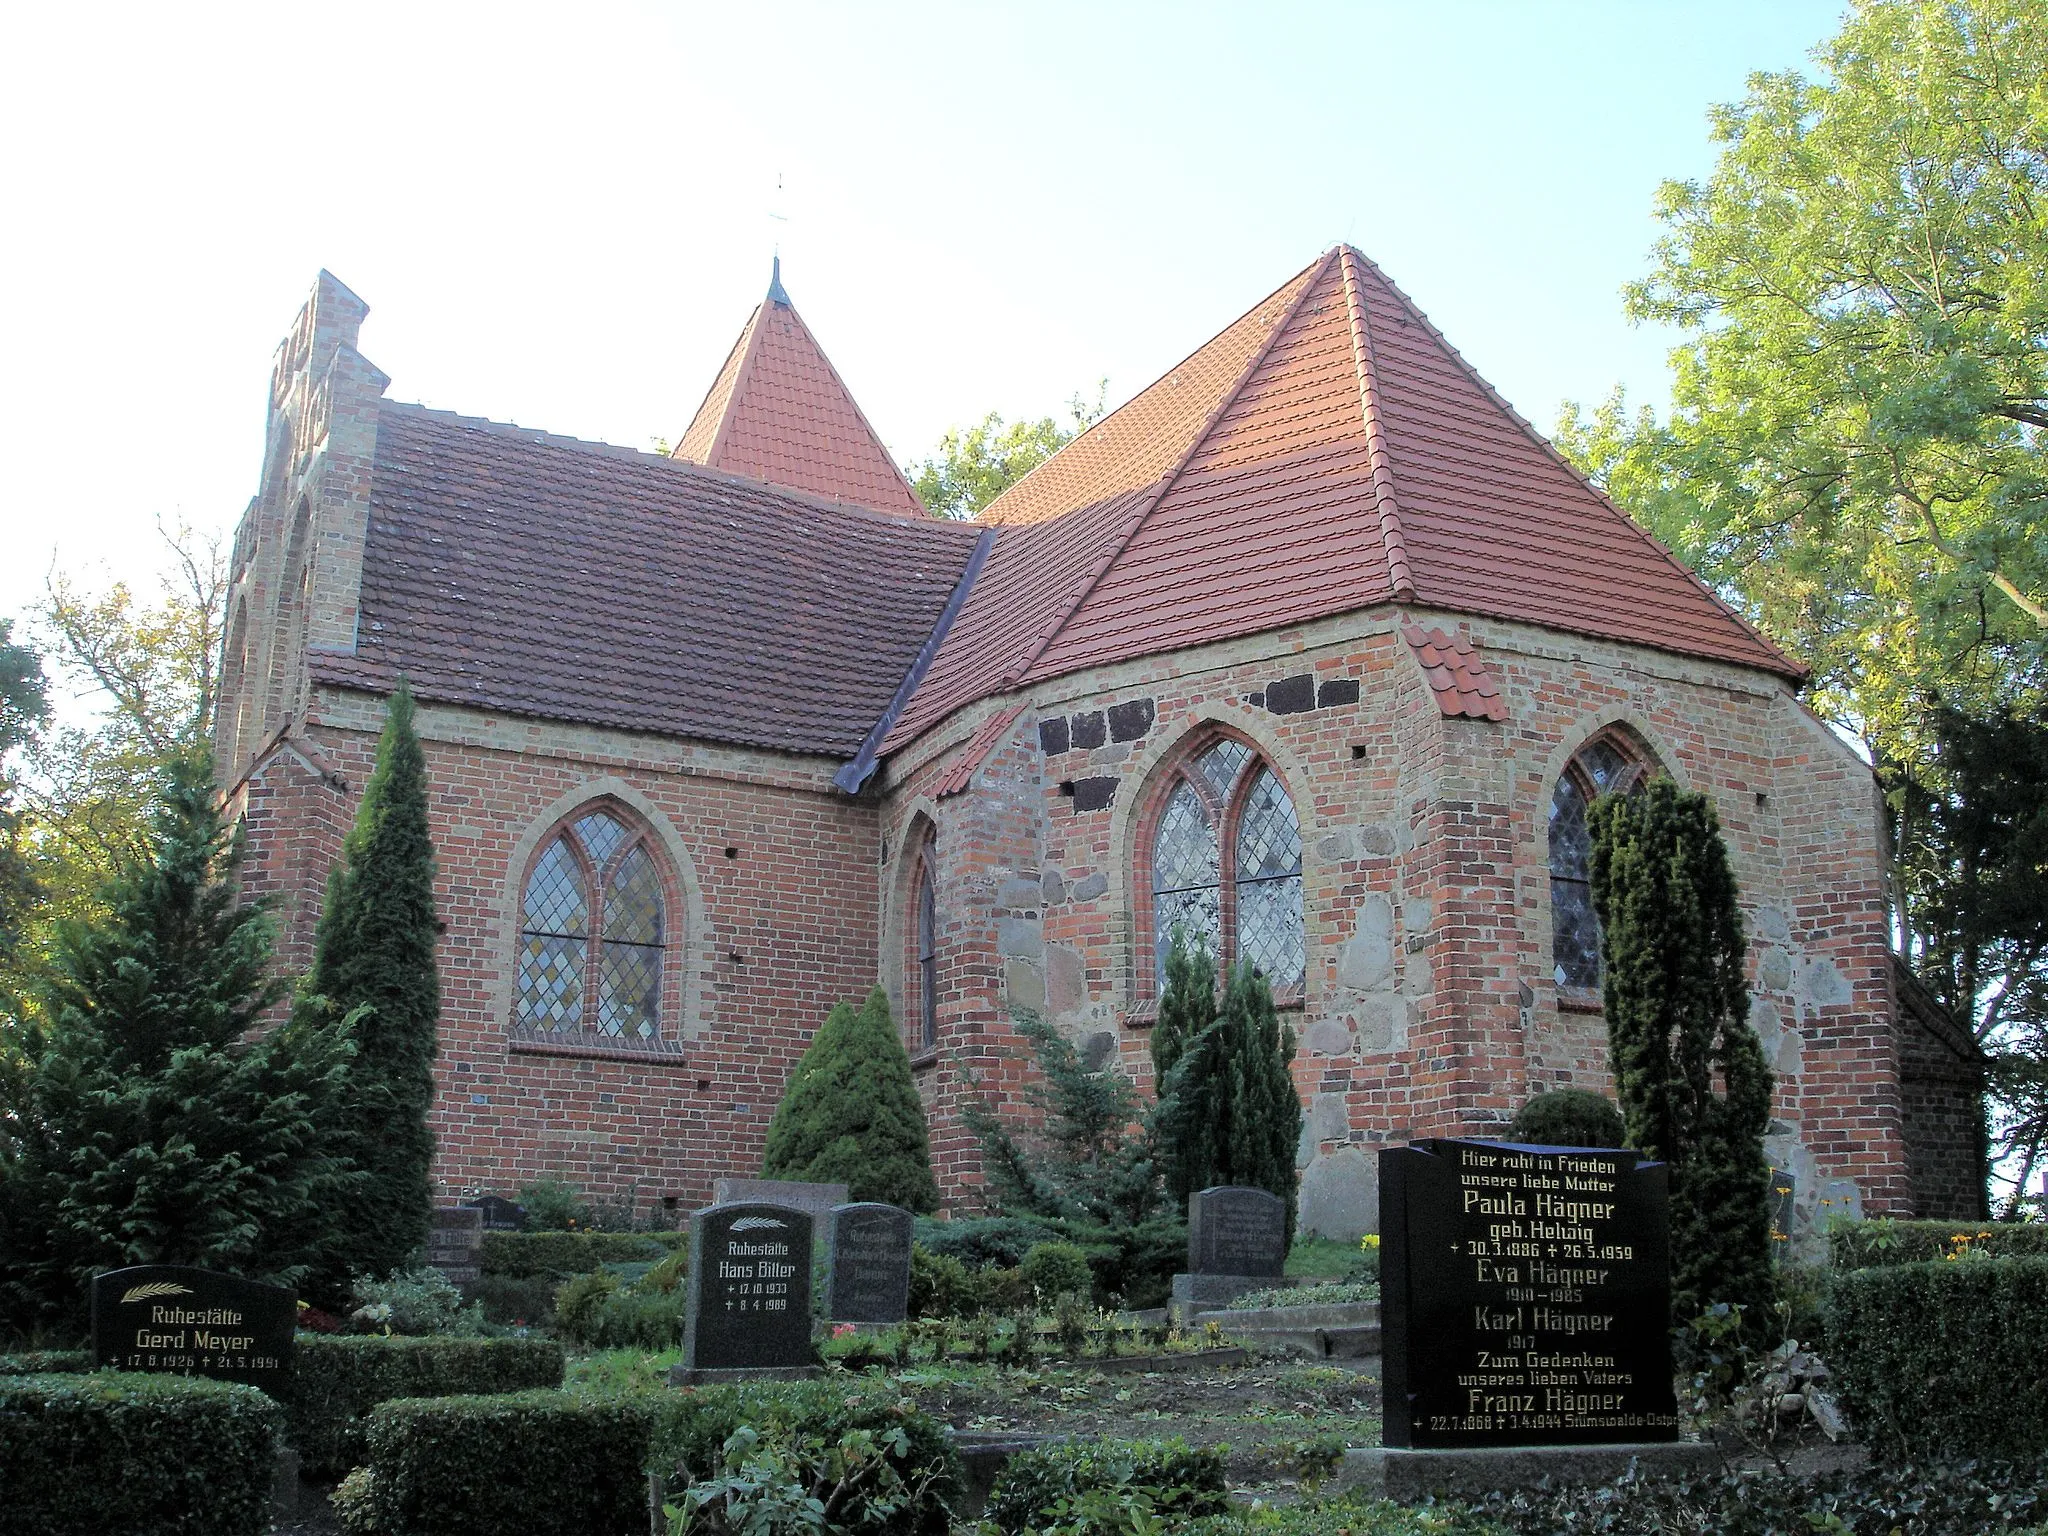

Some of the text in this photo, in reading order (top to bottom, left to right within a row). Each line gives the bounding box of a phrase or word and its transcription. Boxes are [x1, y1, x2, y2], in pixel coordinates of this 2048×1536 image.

[1462, 1150, 1615, 1174] Hier ruht in Frieden
[1461, 1174, 1615, 1192] unsere liebe Mutter
[1464, 1190, 1615, 1223] Paula Hägner
[728, 1242, 788, 1256] Ruhestätte
[1468, 1241, 1632, 1259] 30.3.1886 26.5.1959
[720, 1262, 753, 1278] Hans
[1477, 1258, 1609, 1288] Eva Hägner
[152, 1305, 242, 1325] Ruhestätte
[1475, 1306, 1613, 1336] Karl Hägner
[136, 1329, 254, 1354] Gerd Meyer
[1477, 1352, 1614, 1368] Zum Gedenken
[1458, 1372, 1632, 1386] unseres lieben Vaters
[1469, 1389, 1624, 1417] Franz Hägner
